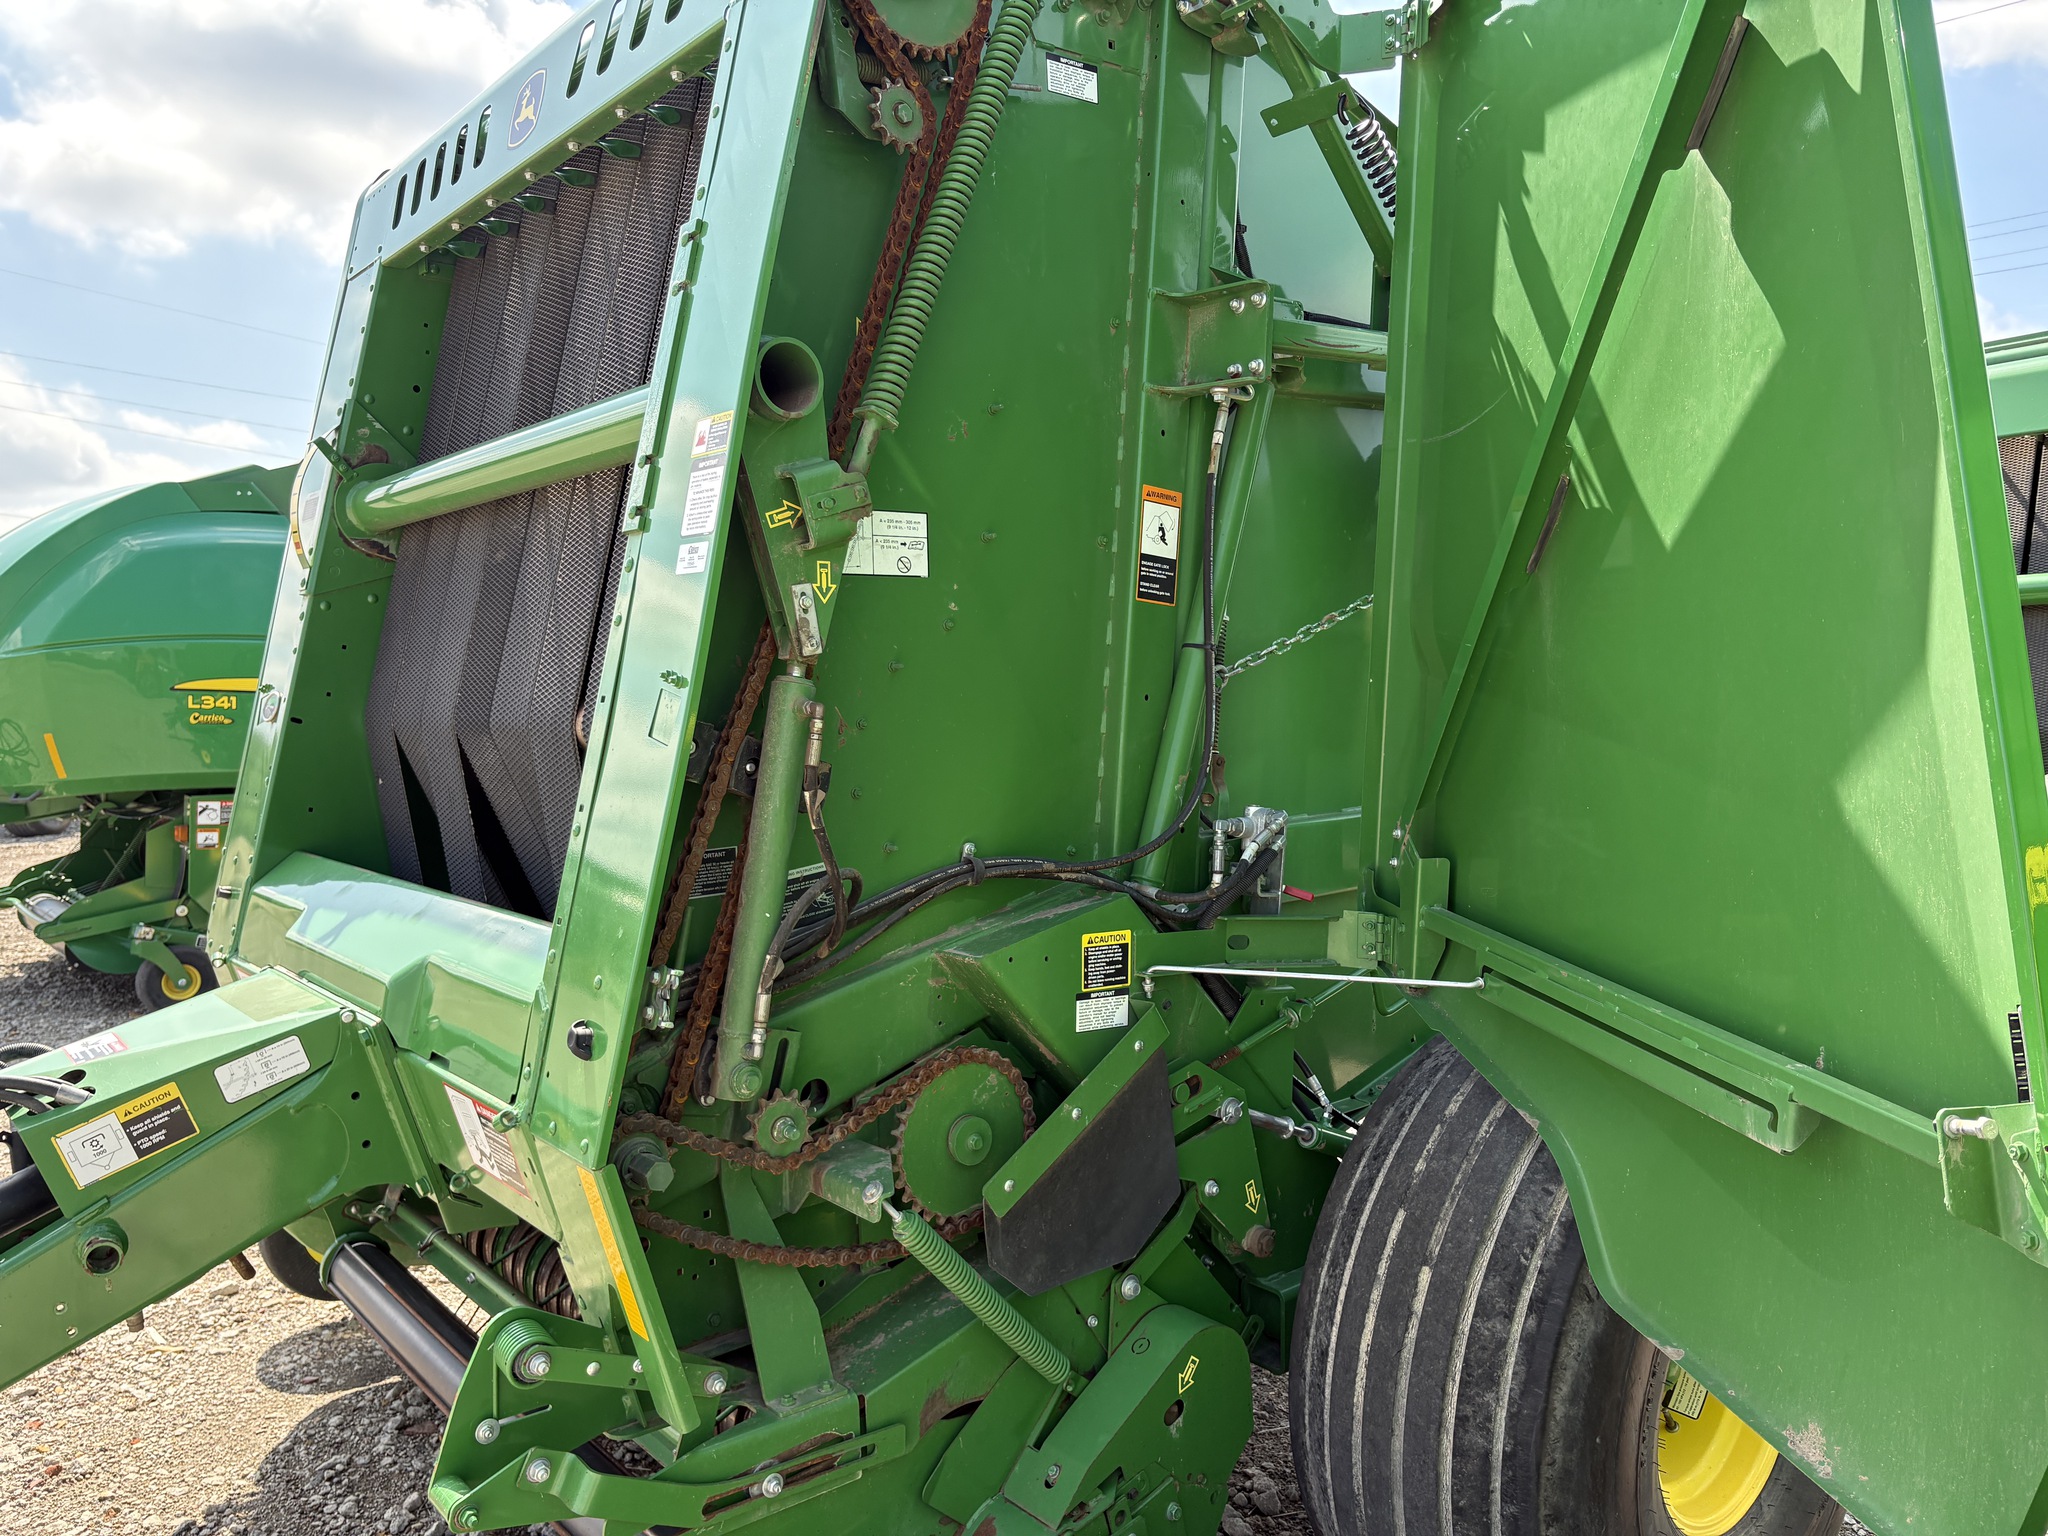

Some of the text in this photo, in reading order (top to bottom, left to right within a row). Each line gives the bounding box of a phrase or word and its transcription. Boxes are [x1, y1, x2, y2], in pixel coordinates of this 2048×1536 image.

[1151, 490, 1177, 502] WARNING
[188, 695, 237, 710] L341
[190, 712, 225, 724] Carrico
[1094, 934, 1126, 944] CAUTION
[132, 1090, 172, 1112] CAUTION
[130, 1122, 144, 1131] Keep
[151, 1110, 170, 1123] shields
[171, 1104, 181, 1113] and
[132, 1126, 148, 1137] guard
[154, 1116, 170, 1127] place.
[137, 1129, 168, 1146] PTO speed:
[140, 1136, 166, 1150] 1000 RPM
[93, 1149, 107, 1158] 1000
